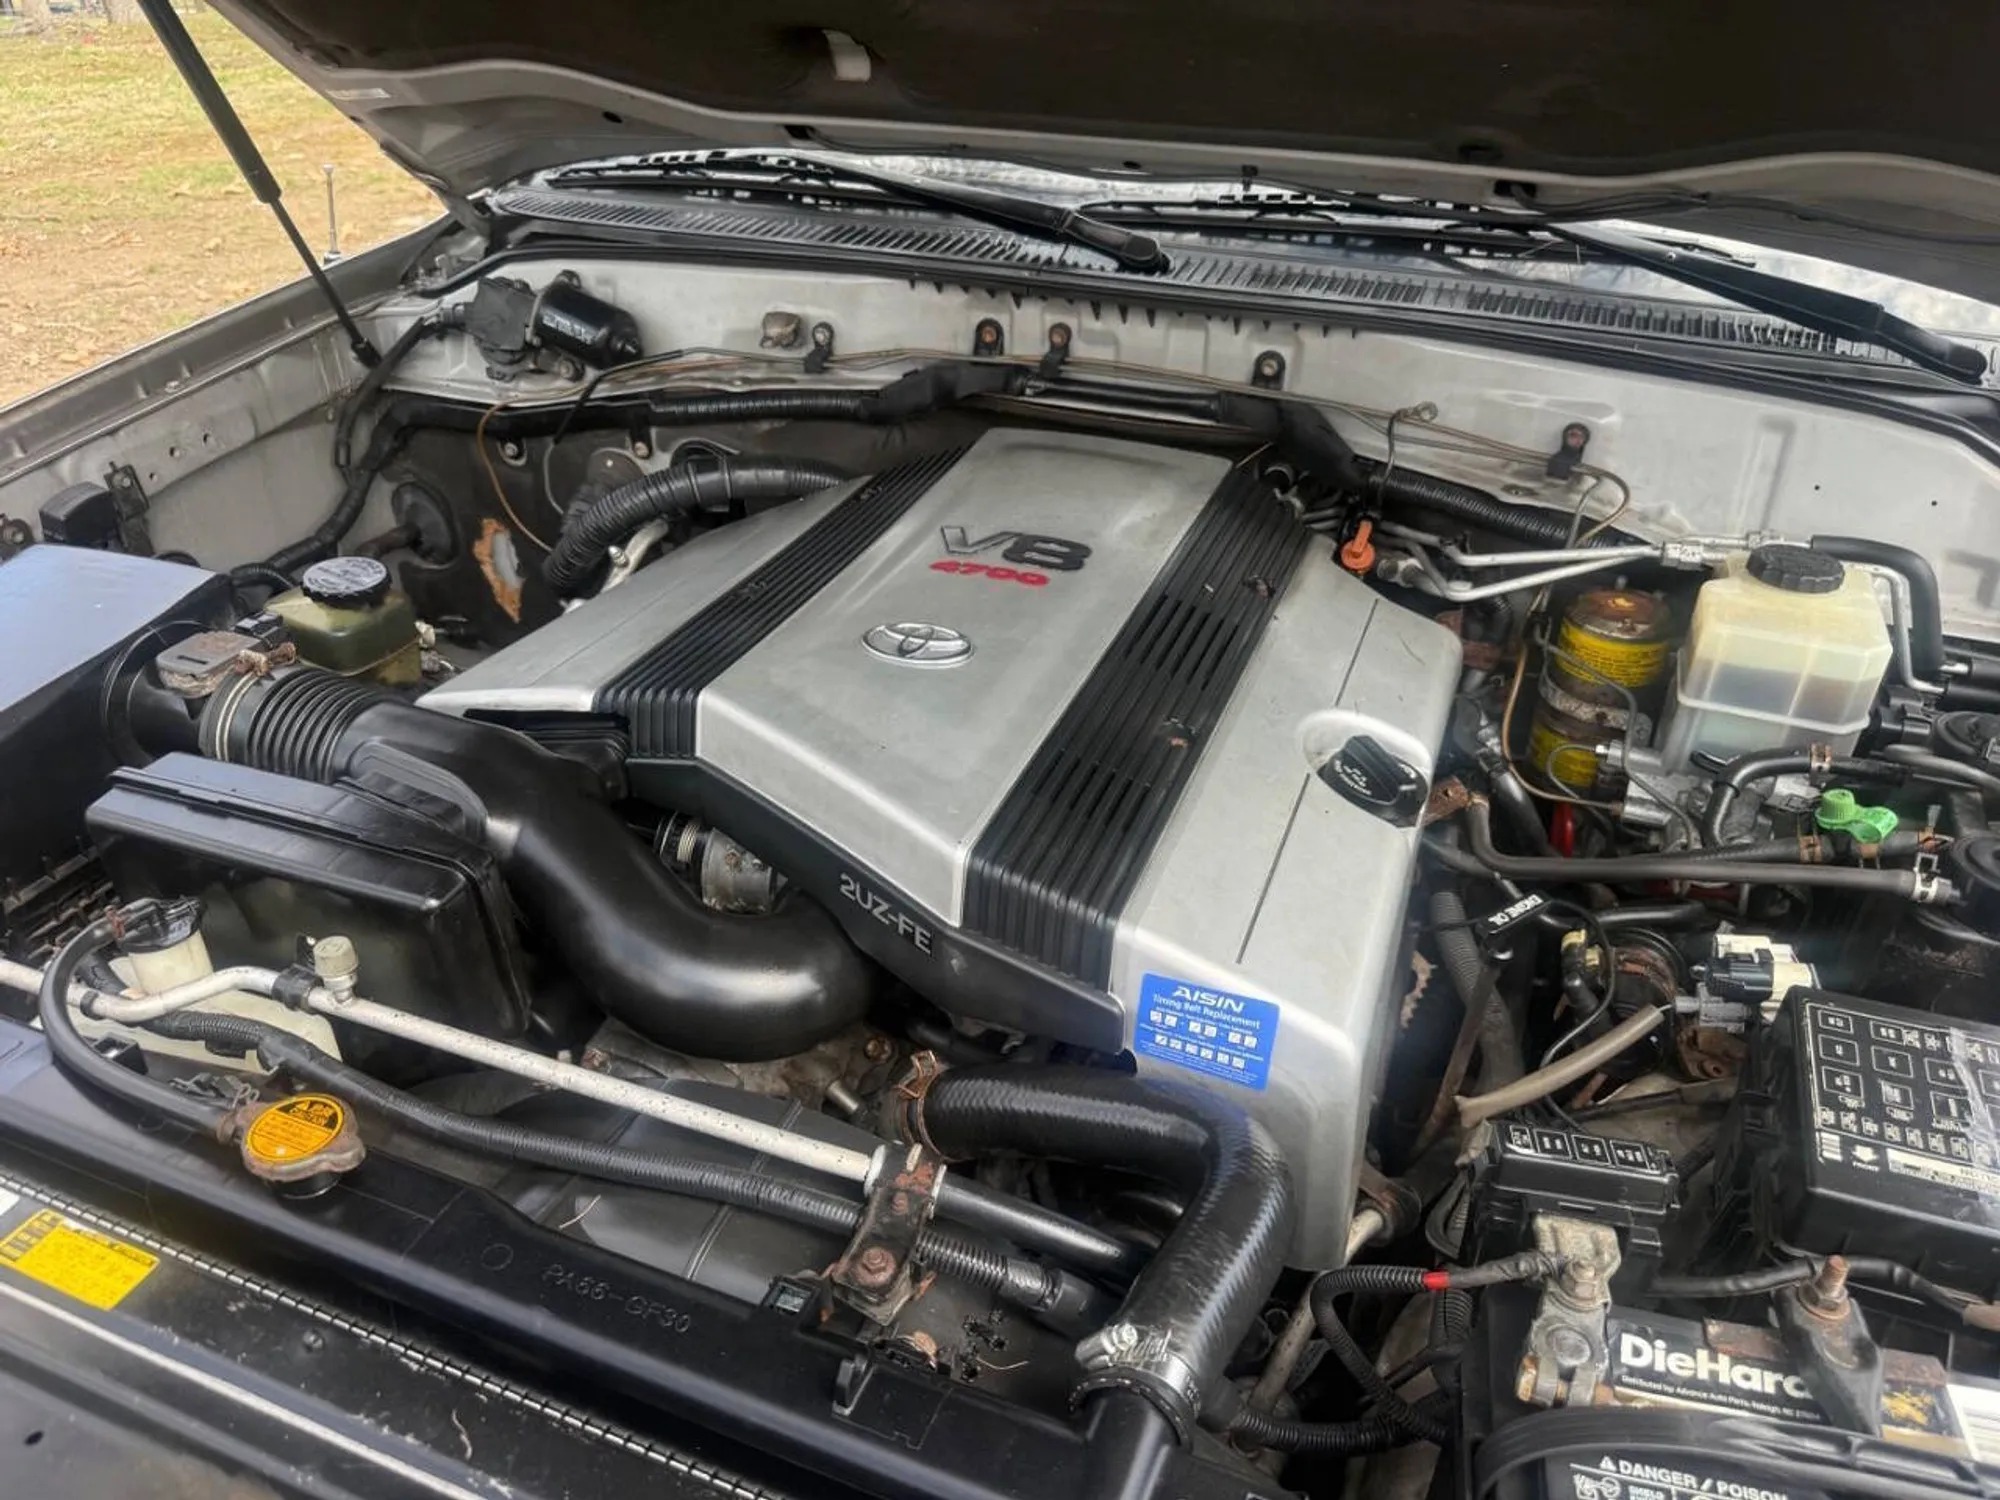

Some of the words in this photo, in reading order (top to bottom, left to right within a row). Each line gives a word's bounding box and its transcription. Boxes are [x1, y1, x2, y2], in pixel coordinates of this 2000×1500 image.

[940, 525, 1093, 571] V8
[929, 560, 1051, 587] 4700
[840, 872, 932, 955] 2UZ-FE
[1153, 993, 1183, 1012] Timing
[1184, 1002, 1202, 1015] Belt
[1203, 1005, 1261, 1030] Replacement
[1172, 985, 1246, 1014] AISIN
[541, 1263, 691, 1334] PA66-GF30
[1618, 1459, 1698, 1489] DANGER
[1716, 1479, 1789, 1500] POISON
